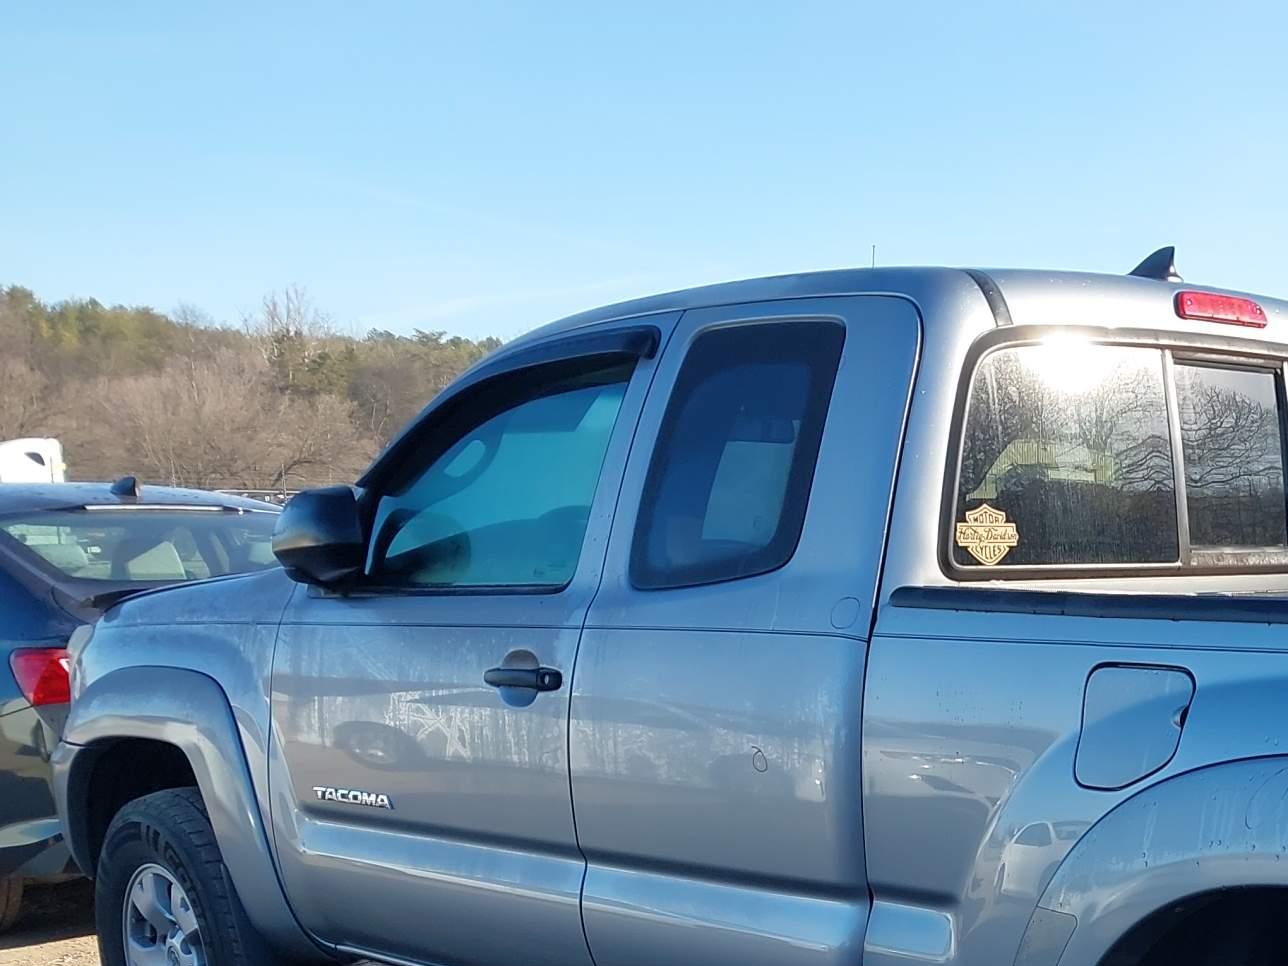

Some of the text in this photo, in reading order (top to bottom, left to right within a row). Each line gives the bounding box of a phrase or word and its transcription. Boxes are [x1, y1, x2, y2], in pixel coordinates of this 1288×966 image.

[973, 511, 999, 524] MOTOR
[975, 545, 1002, 560] CYCLES
[312, 785, 393, 809] TACOMA
